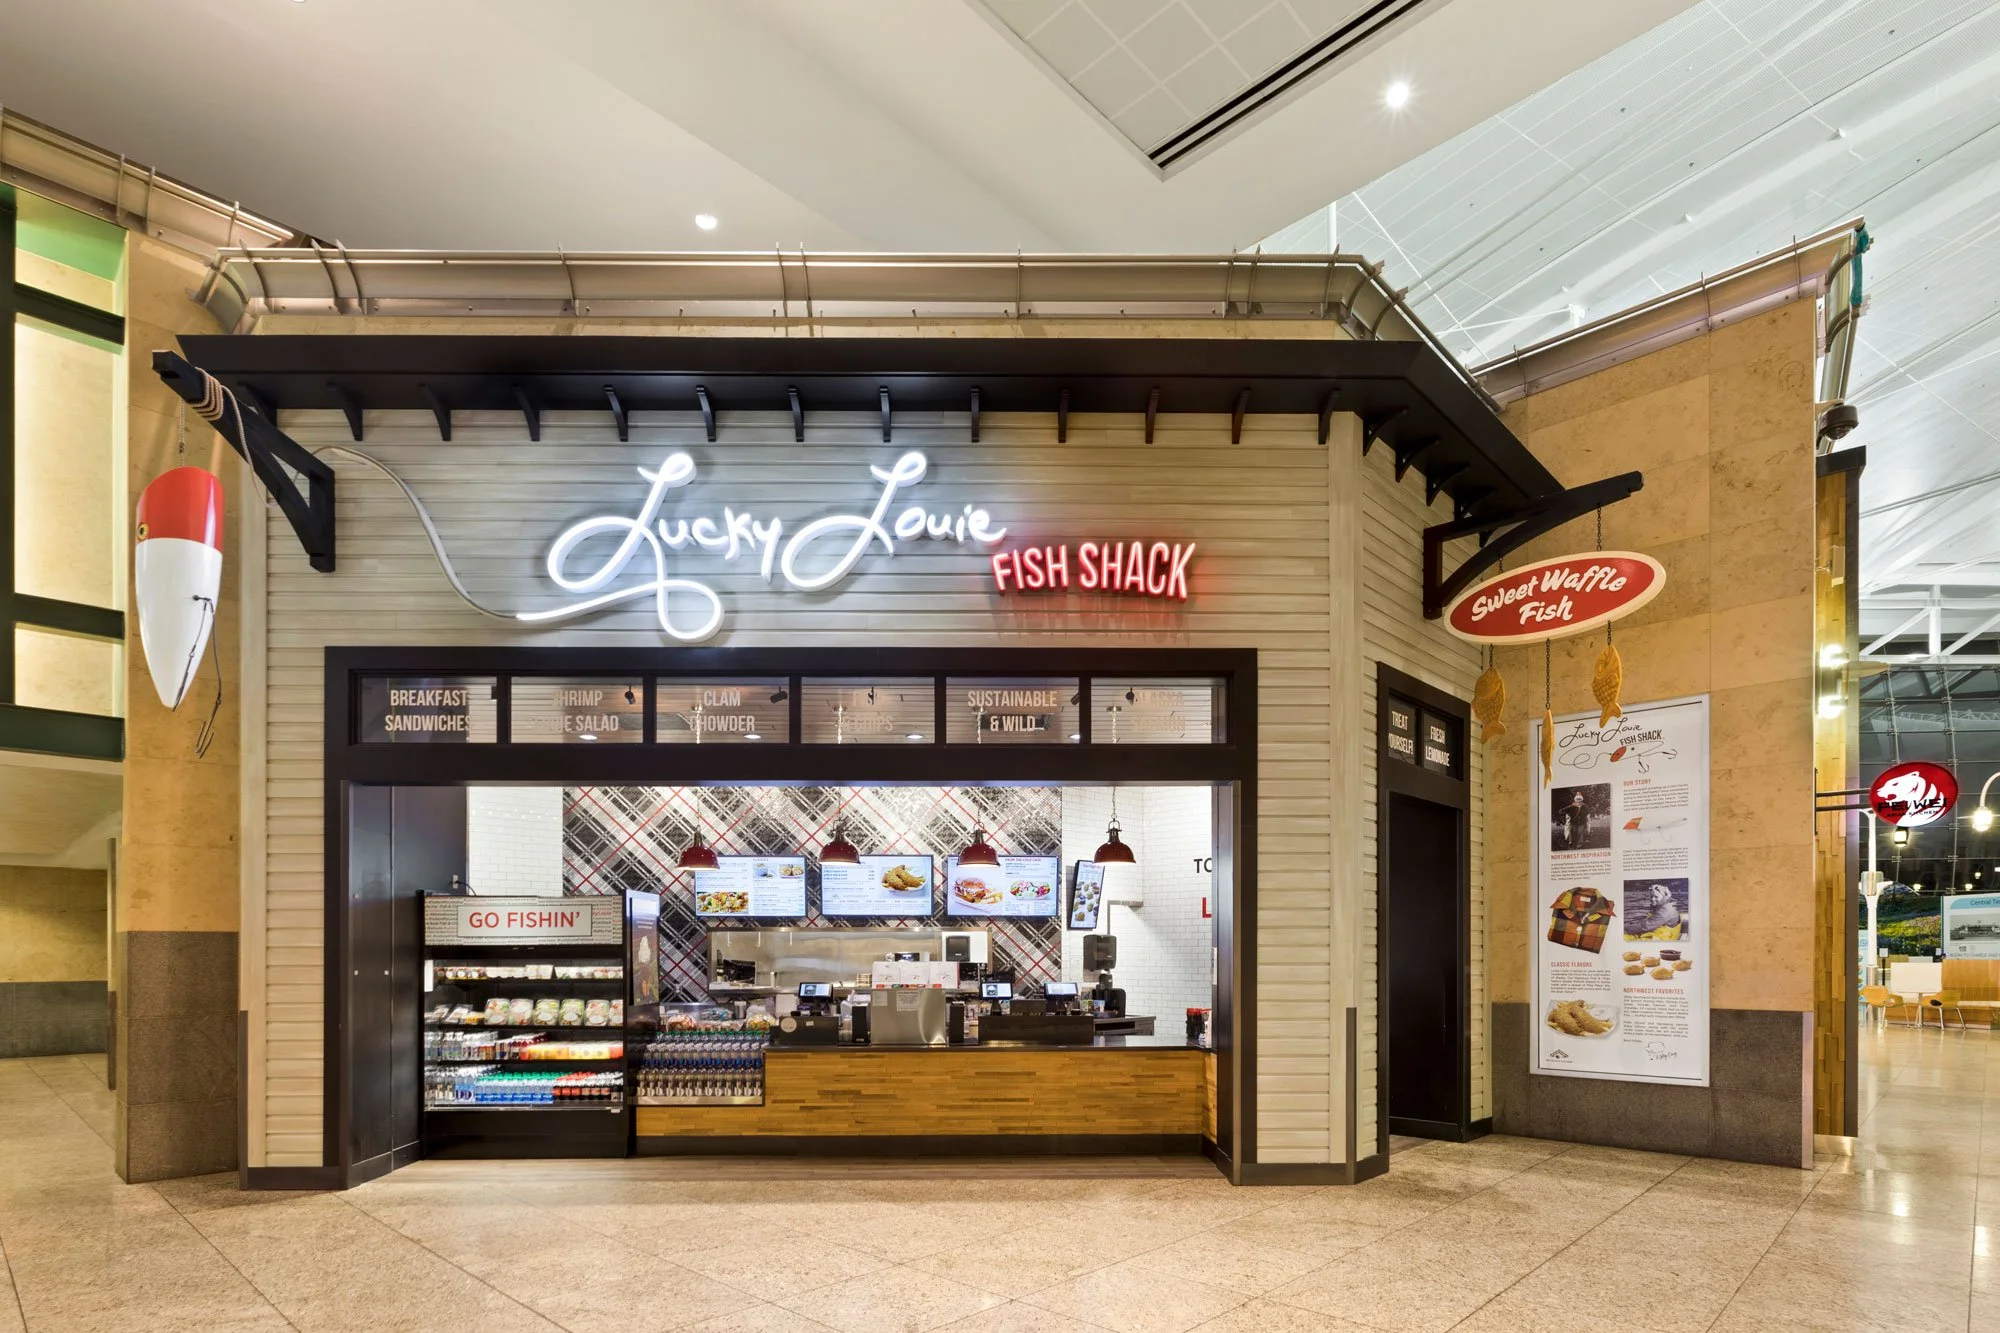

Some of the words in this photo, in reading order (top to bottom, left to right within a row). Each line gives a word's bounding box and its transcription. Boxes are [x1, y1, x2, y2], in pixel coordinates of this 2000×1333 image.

[547, 452, 781, 641] Lucky
[781, 451, 1007, 590] Louie
[992, 545, 1069, 592] FISH
[1077, 541, 1196, 602] SHACK
[1471, 576, 1538, 621] Sweet
[1539, 565, 1628, 592] Waffle
[1519, 595, 1574, 625] Fish
[390, 689, 470, 707] BREAKFAST
[703, 690, 741, 707] CLAM
[967, 690, 1058, 708] SUSTAINABLE
[575, 714, 619, 732] SALAD
[688, 715, 755, 732] CHOWDER
[989, 715, 1001, 732] &
[1002, 715, 1036, 732] WILD
[1391, 711, 1409, 731] TREAT
[1430, 725, 1446, 745] FRESH
[1559, 723, 1601, 747] Lucky
[1601, 717, 1643, 742] Louie
[1620, 734, 1637, 746] FISH
[1637, 730, 1663, 742] SHACK
[1425, 746, 1450, 767] LEMONADE
[1634, 778, 1651, 786] STORY
[1913, 797, 1946, 809] WEI
[1580, 851, 1611, 859] INSPIRATION
[1970, 898, 1991, 906] Central
[468, 911, 499, 929] GO
